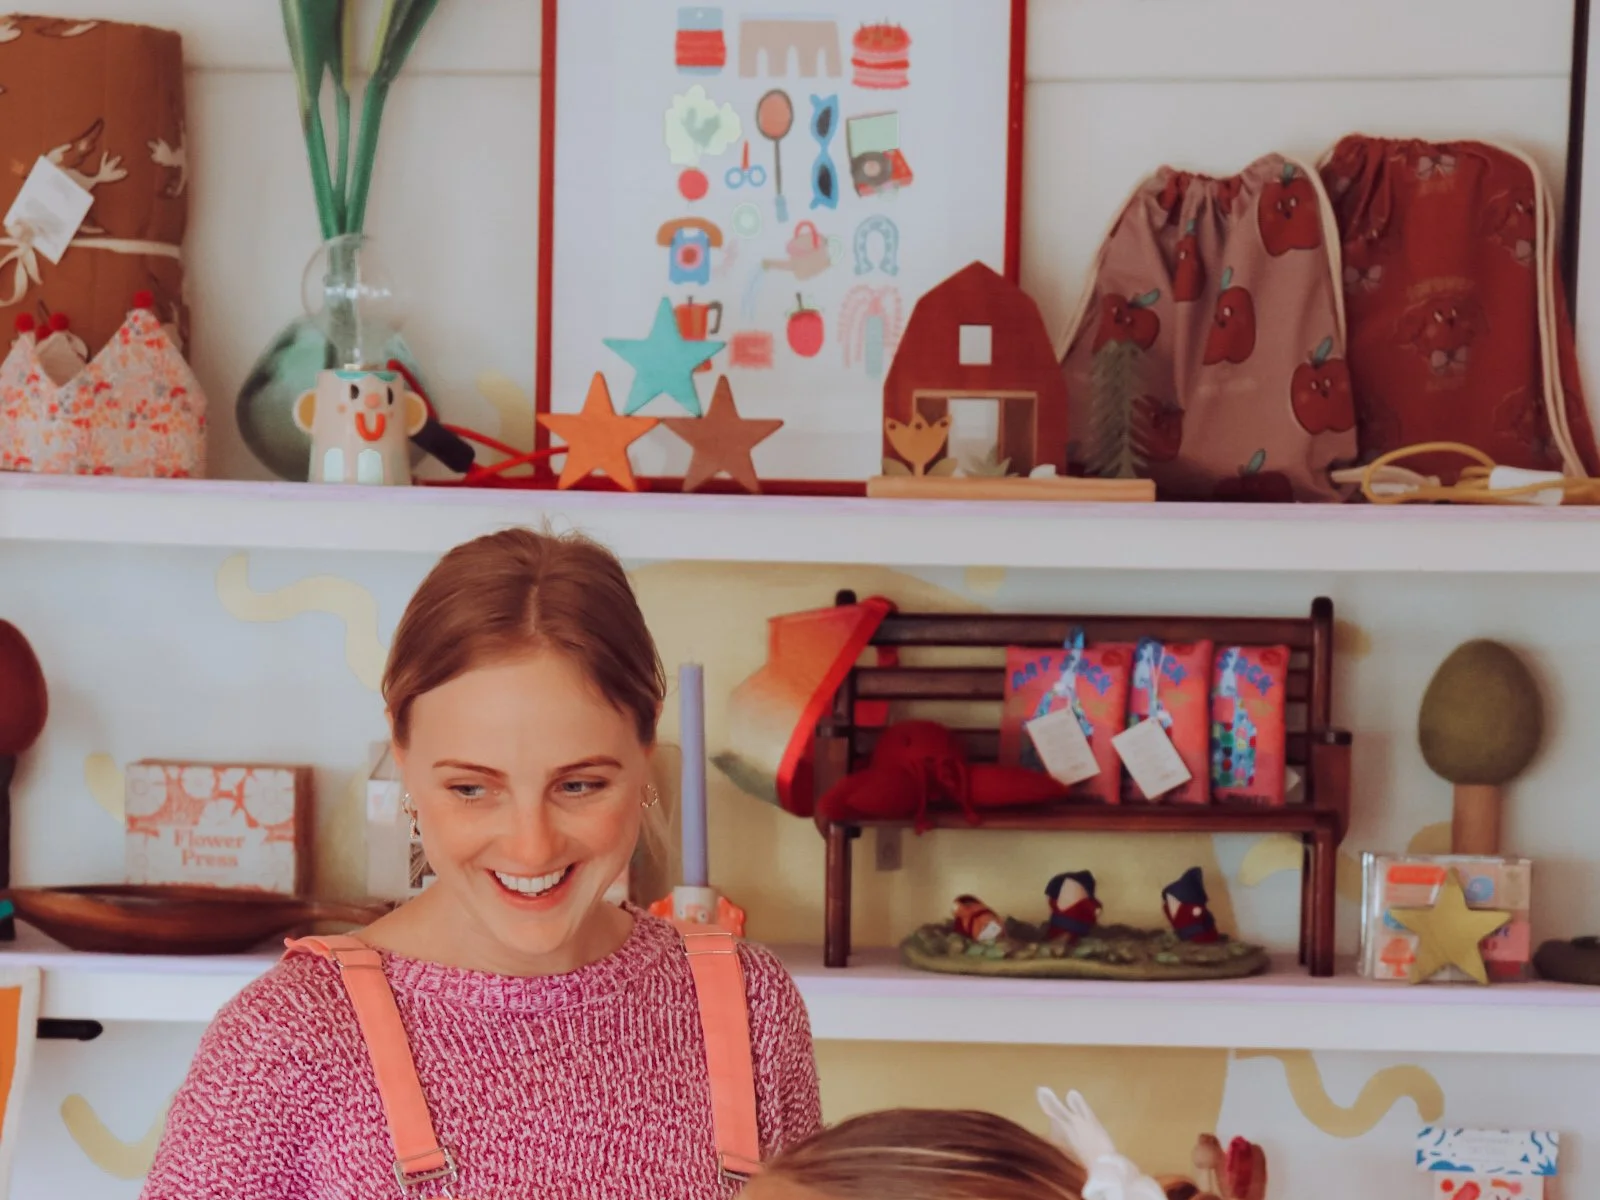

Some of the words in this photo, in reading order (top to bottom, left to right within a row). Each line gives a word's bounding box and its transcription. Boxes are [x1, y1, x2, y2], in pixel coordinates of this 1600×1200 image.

[1012, 655, 1051, 692] ART
[174, 828, 245, 848] Flower
[182, 849, 239, 867] Press
